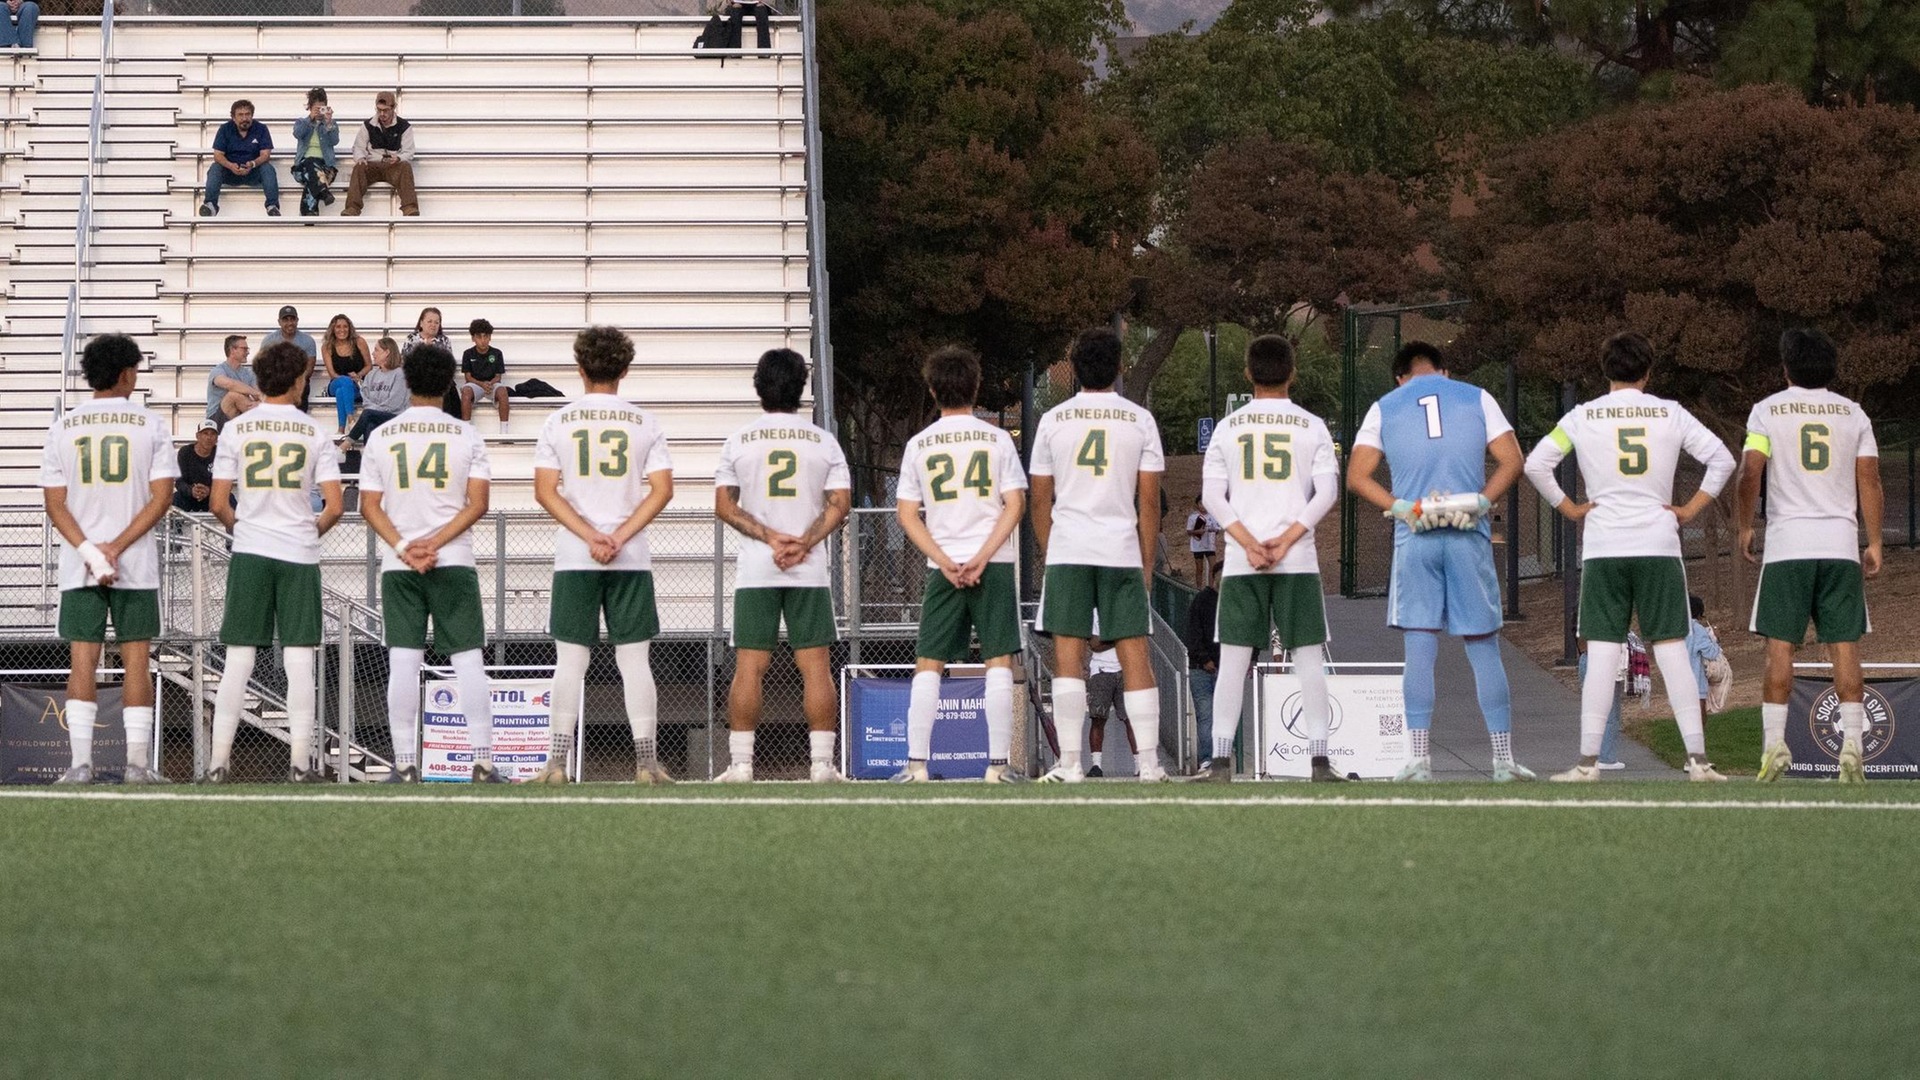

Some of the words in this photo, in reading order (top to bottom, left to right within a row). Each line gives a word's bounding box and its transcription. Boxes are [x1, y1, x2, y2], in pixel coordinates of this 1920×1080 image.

[561, 409, 643, 424] RENEGADES
[1052, 408, 1137, 423] RENEGADES
[1417, 393, 1443, 439] 1
[1586, 407, 1668, 420] RENEGADES
[1770, 402, 1851, 416] RENEGADES
[63, 412, 146, 429] RENEGADES
[236, 420, 317, 436] RENEGADES
[1229, 413, 1310, 428] RENEGADES
[381, 422, 462, 437] RENEGADES
[741, 429, 822, 443] RENEGADES
[917, 430, 998, 449] RENEGADES
[1800, 423, 1830, 471] 6
[74, 434, 129, 484] 10
[571, 428, 629, 477] 13
[1076, 429, 1108, 476] 4
[1237, 432, 1292, 480] 15
[1617, 427, 1648, 475] 5
[244, 441, 307, 489] 22
[389, 441, 449, 489] 14
[767, 450, 797, 497] 2
[926, 450, 993, 502] 24
[489, 690, 526, 702] iTOL
[937, 698, 959, 710] ANIN
[961, 698, 986, 710] MAHI
[935, 711, 977, 720] 08-679-0320
[1866, 698, 1887, 722] GYM
[431, 715, 449, 723] FOR
[450, 716, 466, 724] ALL
[494, 717, 535, 725] PRINTING
[537, 717, 549, 725] NE
[8, 740, 62, 748] WORLDWIDE
[429, 763, 474, 772] 408-923-
[1791, 763, 1813, 771] HUGO
